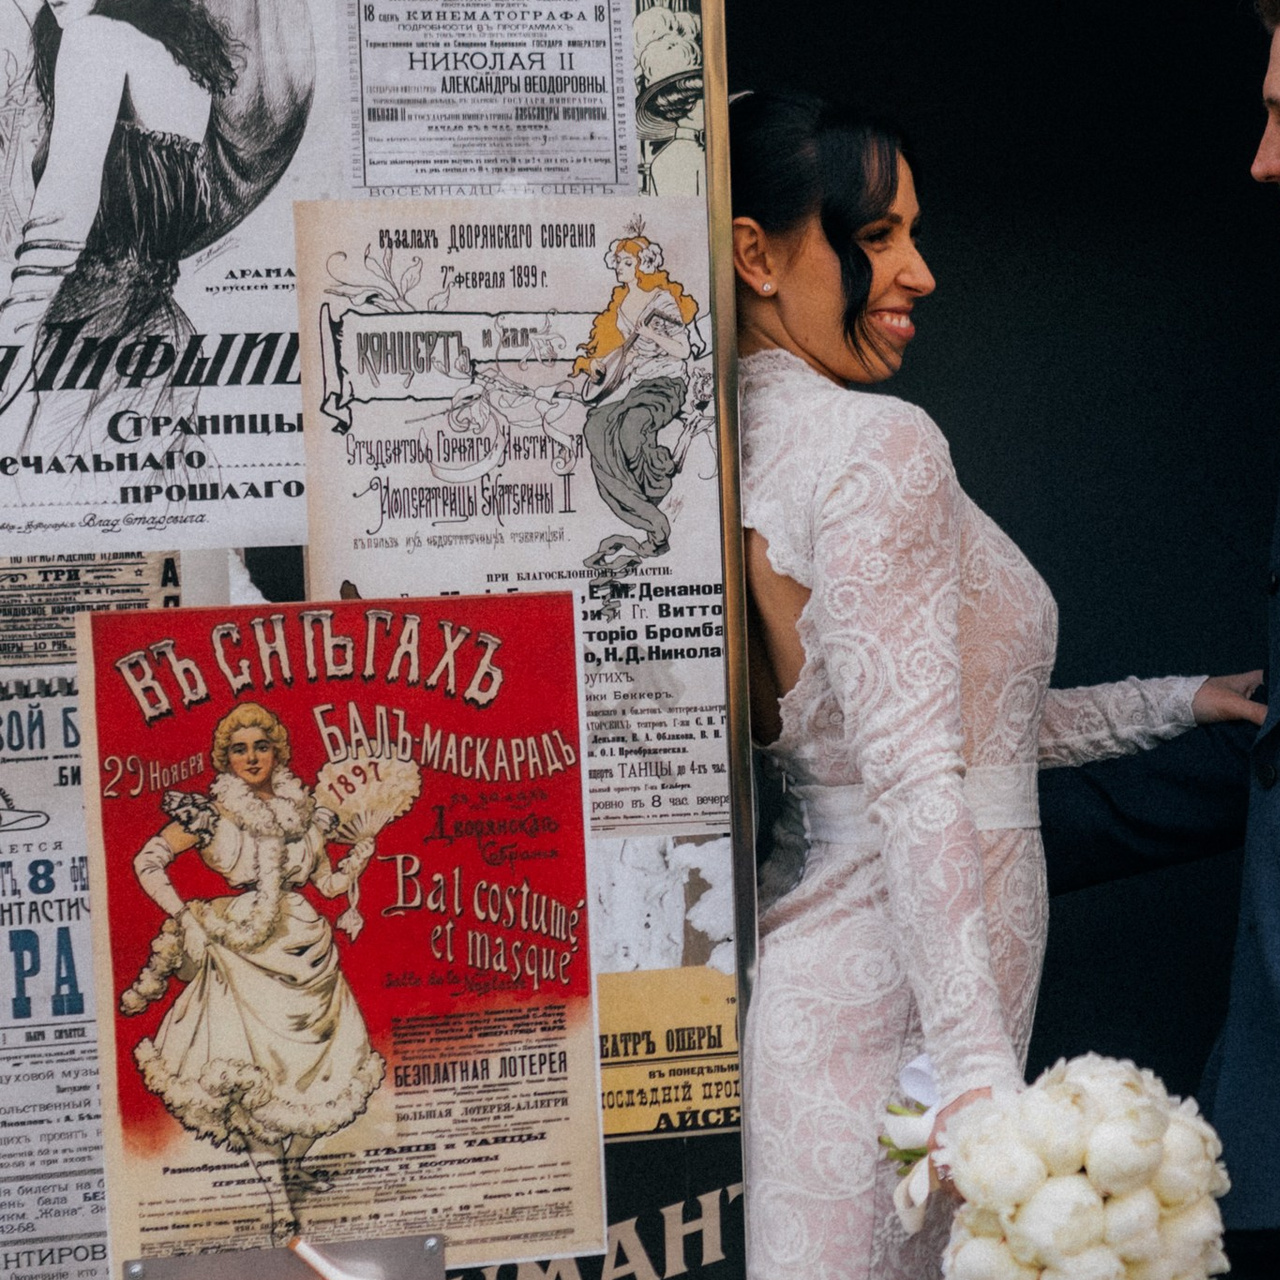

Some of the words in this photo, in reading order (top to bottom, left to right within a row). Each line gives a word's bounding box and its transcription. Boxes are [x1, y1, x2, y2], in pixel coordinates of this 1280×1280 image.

[406, 10, 588, 21] КИНЕМАТОГРАФА
[408, 51, 546, 71] НИКОЛАЯ
[440, 75, 521, 96] АЛЕКСАНДРЫ
[509, 264, 538, 289] 1899
[38, 568, 81, 583] ТРИ
[658, 602, 723, 619] Витто
[115, 638, 212, 726] ВЪ
[0, 703, 46, 753] ОЙ
[312, 700, 577, 782] БАЛЪ-МАСКАРАДЪ
[102, 755, 145, 801] 29
[326, 760, 384, 806] 1897
[617, 760, 672, 780] ТАНЦЫ
[592, 800, 624, 813] ровно
[651, 794, 662, 809] 8
[0, 841, 64, 855] ЕТСЯ
[377, 853, 464, 917] Bal
[430, 919, 455, 963] et
[8, 925, 86, 1020] РА
[665, 1024, 724, 1053] ОПЕРЫ
[394, 1058, 490, 1088] БЕЗПЛАТНАЯ
[498, 1050, 568, 1079] ЛОТЕРЕЯ
[16, 1179, 70, 1196] билеты
[2, 1242, 108, 1270] НТИРОВ
